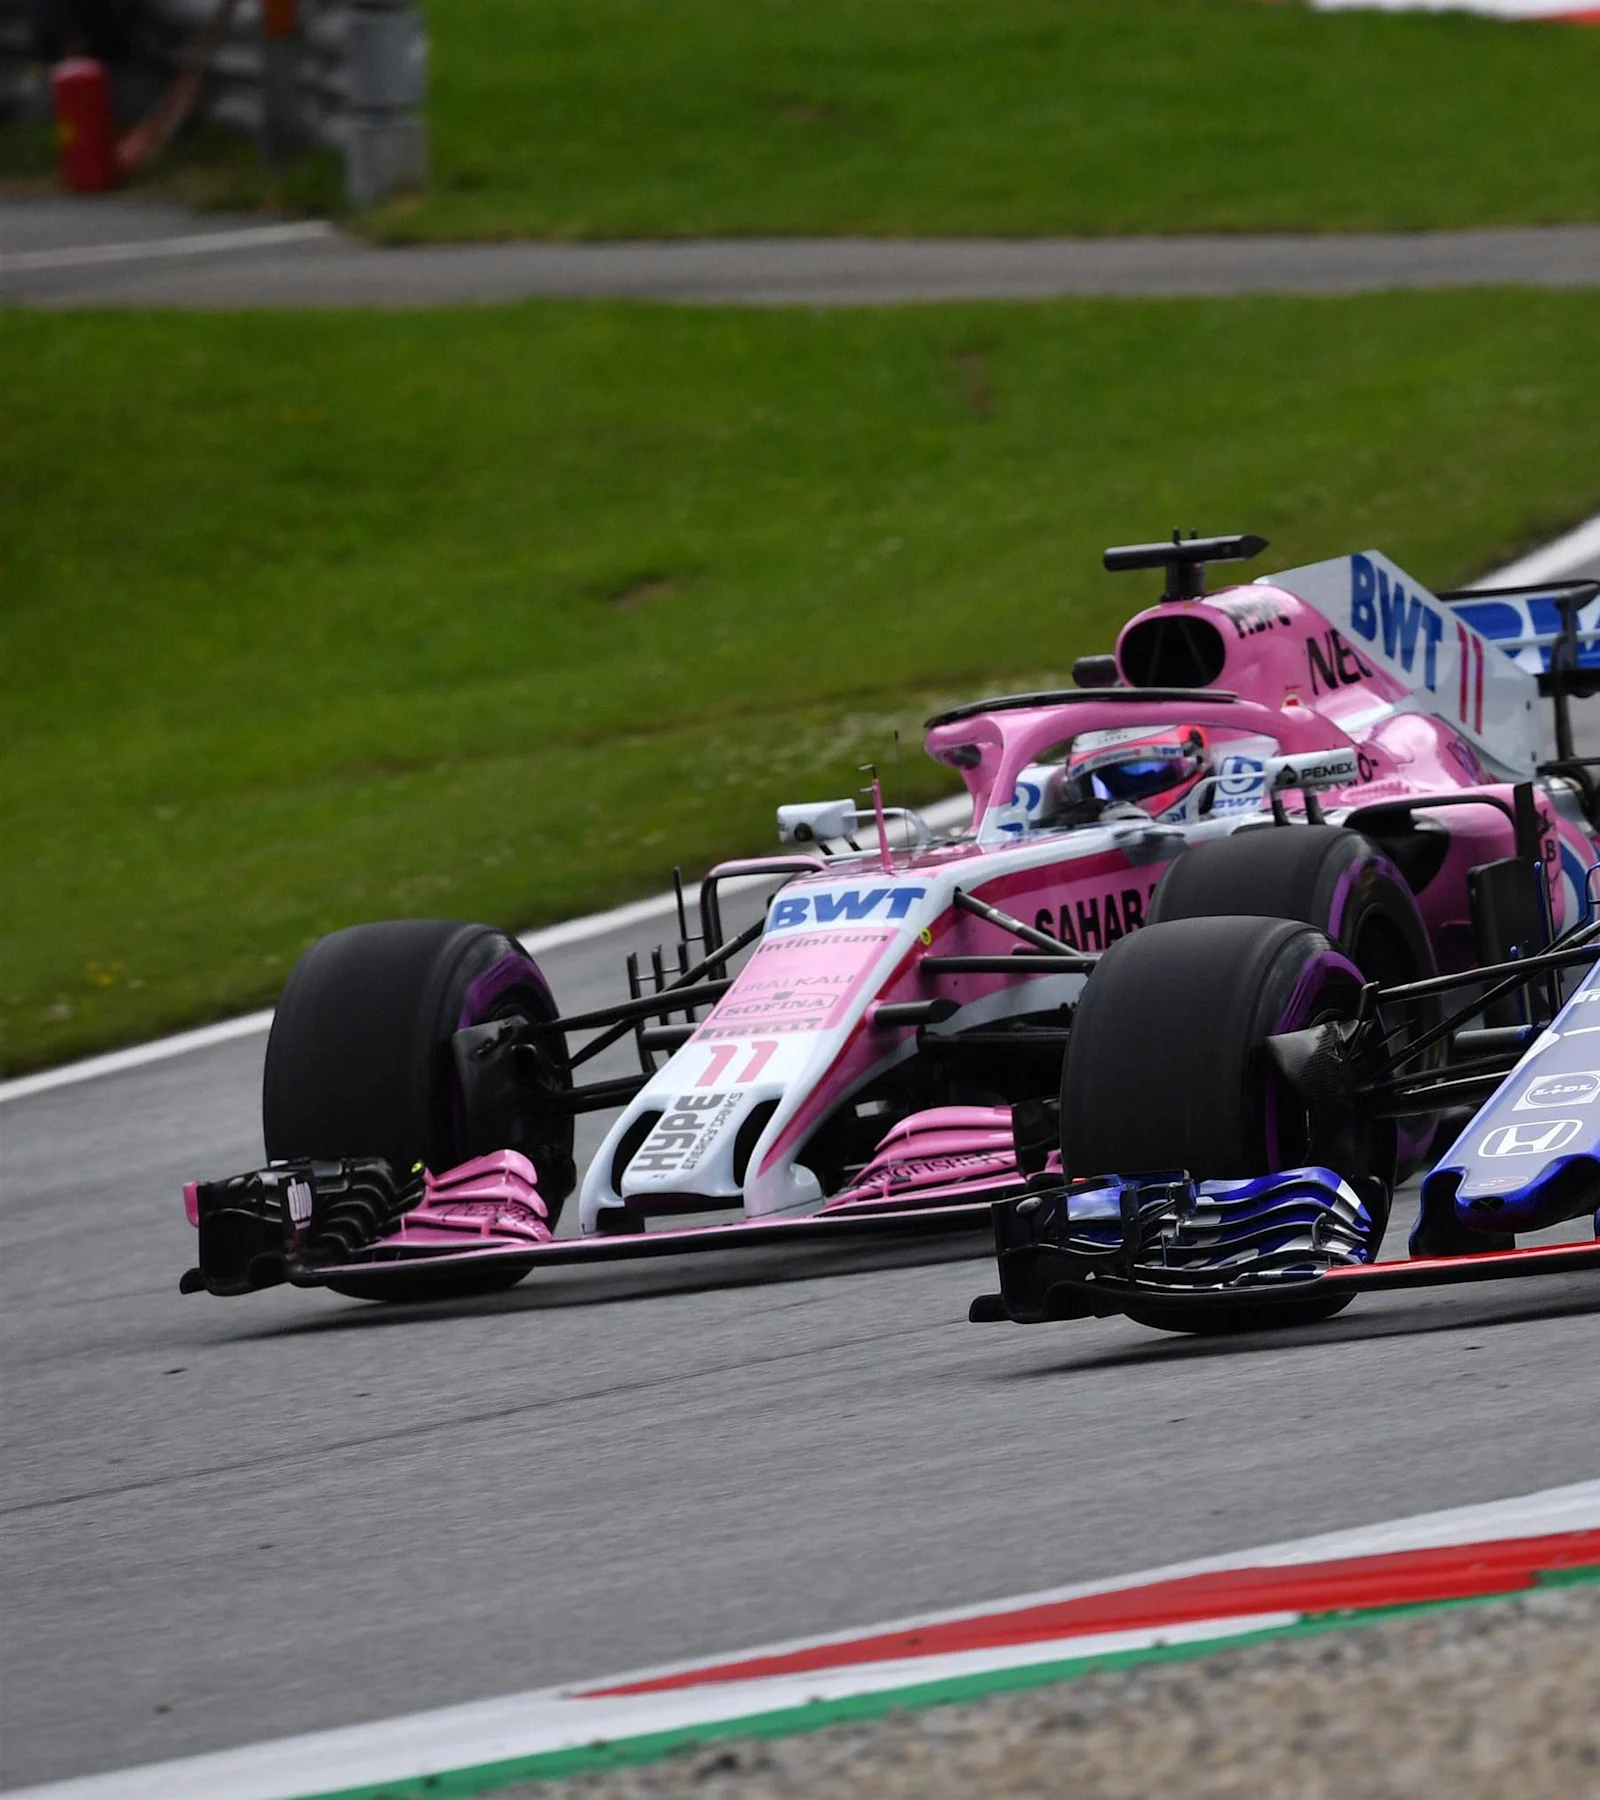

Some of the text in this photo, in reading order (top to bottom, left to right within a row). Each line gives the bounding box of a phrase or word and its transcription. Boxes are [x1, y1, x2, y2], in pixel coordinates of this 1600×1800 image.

[1351, 553, 1443, 693] BWT
[1455, 620, 1484, 736] 11
[1301, 761, 1353, 780] PEMEX
[767, 887, 927, 933] BWT
[1035, 884, 1156, 952] SAHAR
[699, 1018, 822, 1040] PIRELLI
[724, 1001, 826, 1017] SOFINA
[694, 1040, 779, 1088] 11
[629, 1093, 726, 1172] HYPE
